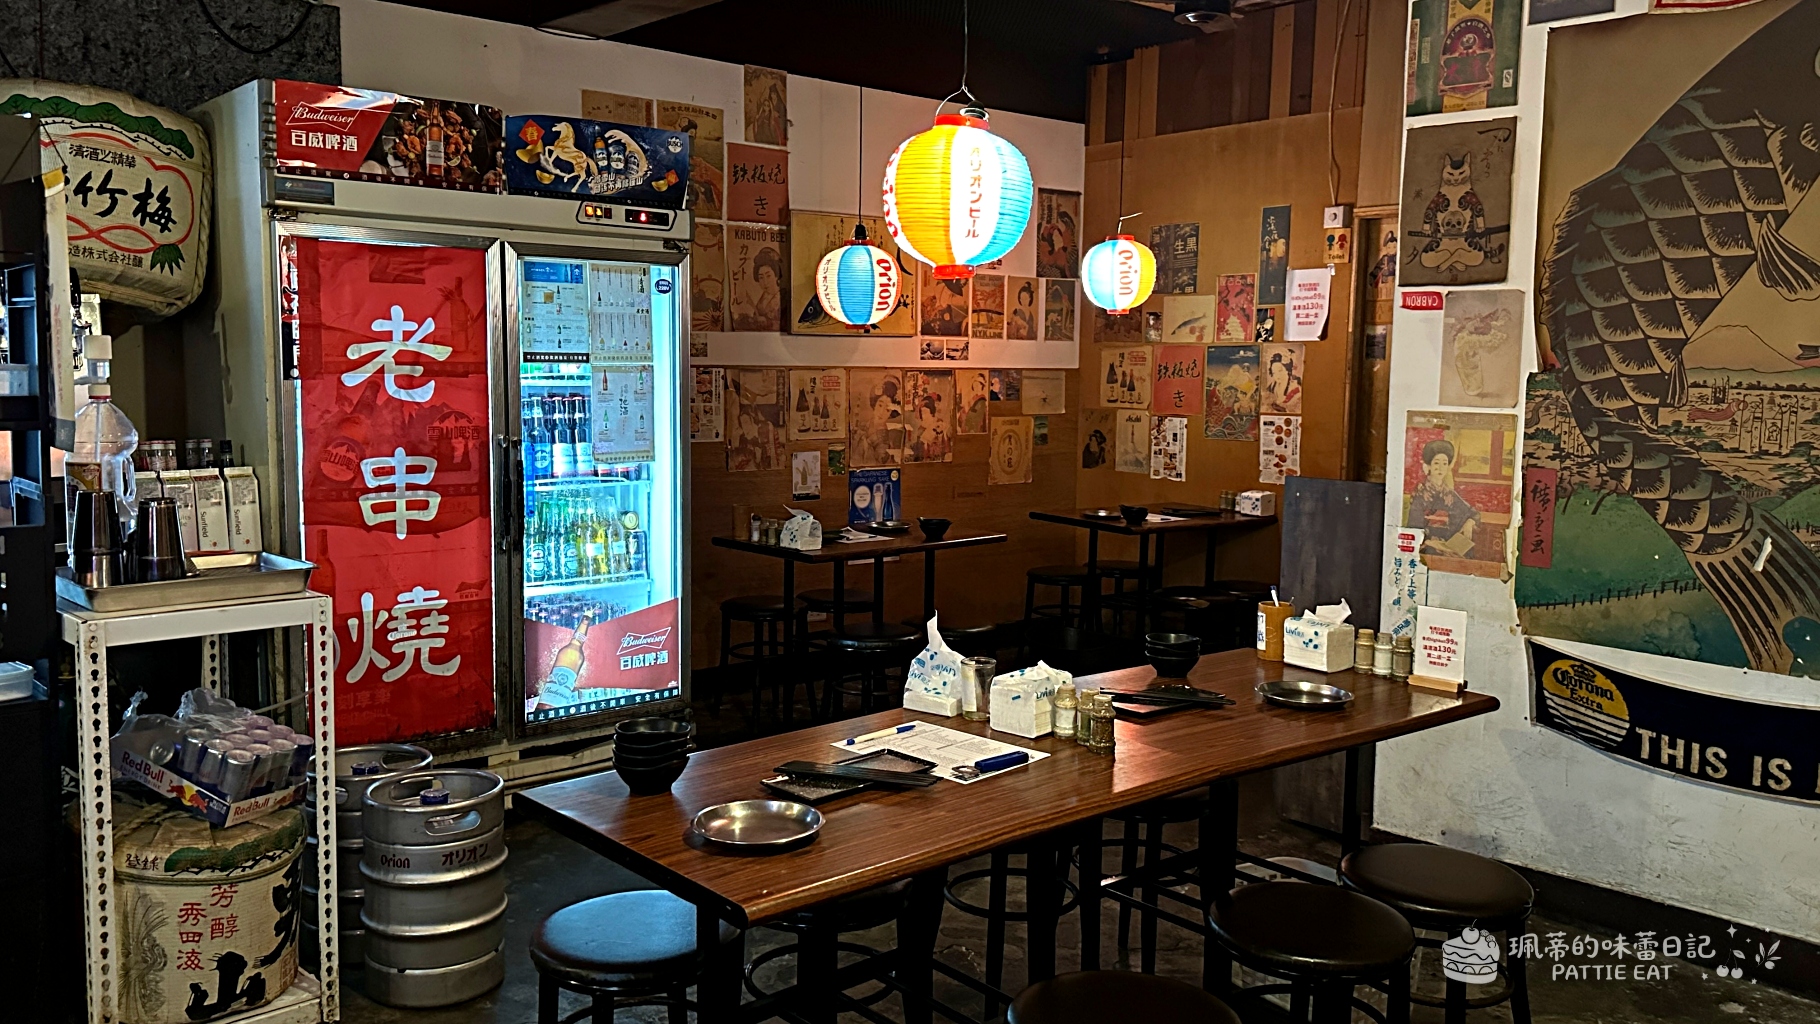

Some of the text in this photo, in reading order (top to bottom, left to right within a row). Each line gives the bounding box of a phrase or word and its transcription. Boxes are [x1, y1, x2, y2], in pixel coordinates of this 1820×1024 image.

[292, 106, 354, 124] Budweiser
[290, 129, 358, 152] 百威啤酒
[667, 140, 684, 149] BUSCH
[62, 165, 178, 234] 竹梅
[734, 229, 787, 244] KABUTO BEE
[341, 305, 462, 684] 老串燒
[200, 511, 209, 538] Sunfield
[233, 509, 243, 536] Sunfield
[622, 634, 667, 648] Budweiser
[619, 651, 669, 671] 百威啤酒
[1552, 666, 1616, 703] Corona
[1569, 687, 1604, 712] Extra
[121, 751, 165, 784] Red Bull
[1635, 726, 1729, 780] THIS
[1751, 755, 1793, 792] IS
[233, 803, 253, 817] Red
[252, 796, 271, 811] Bull
[380, 853, 411, 869] Orion
[441, 843, 489, 867] オリオン
[209, 882, 241, 941] 芳醇
